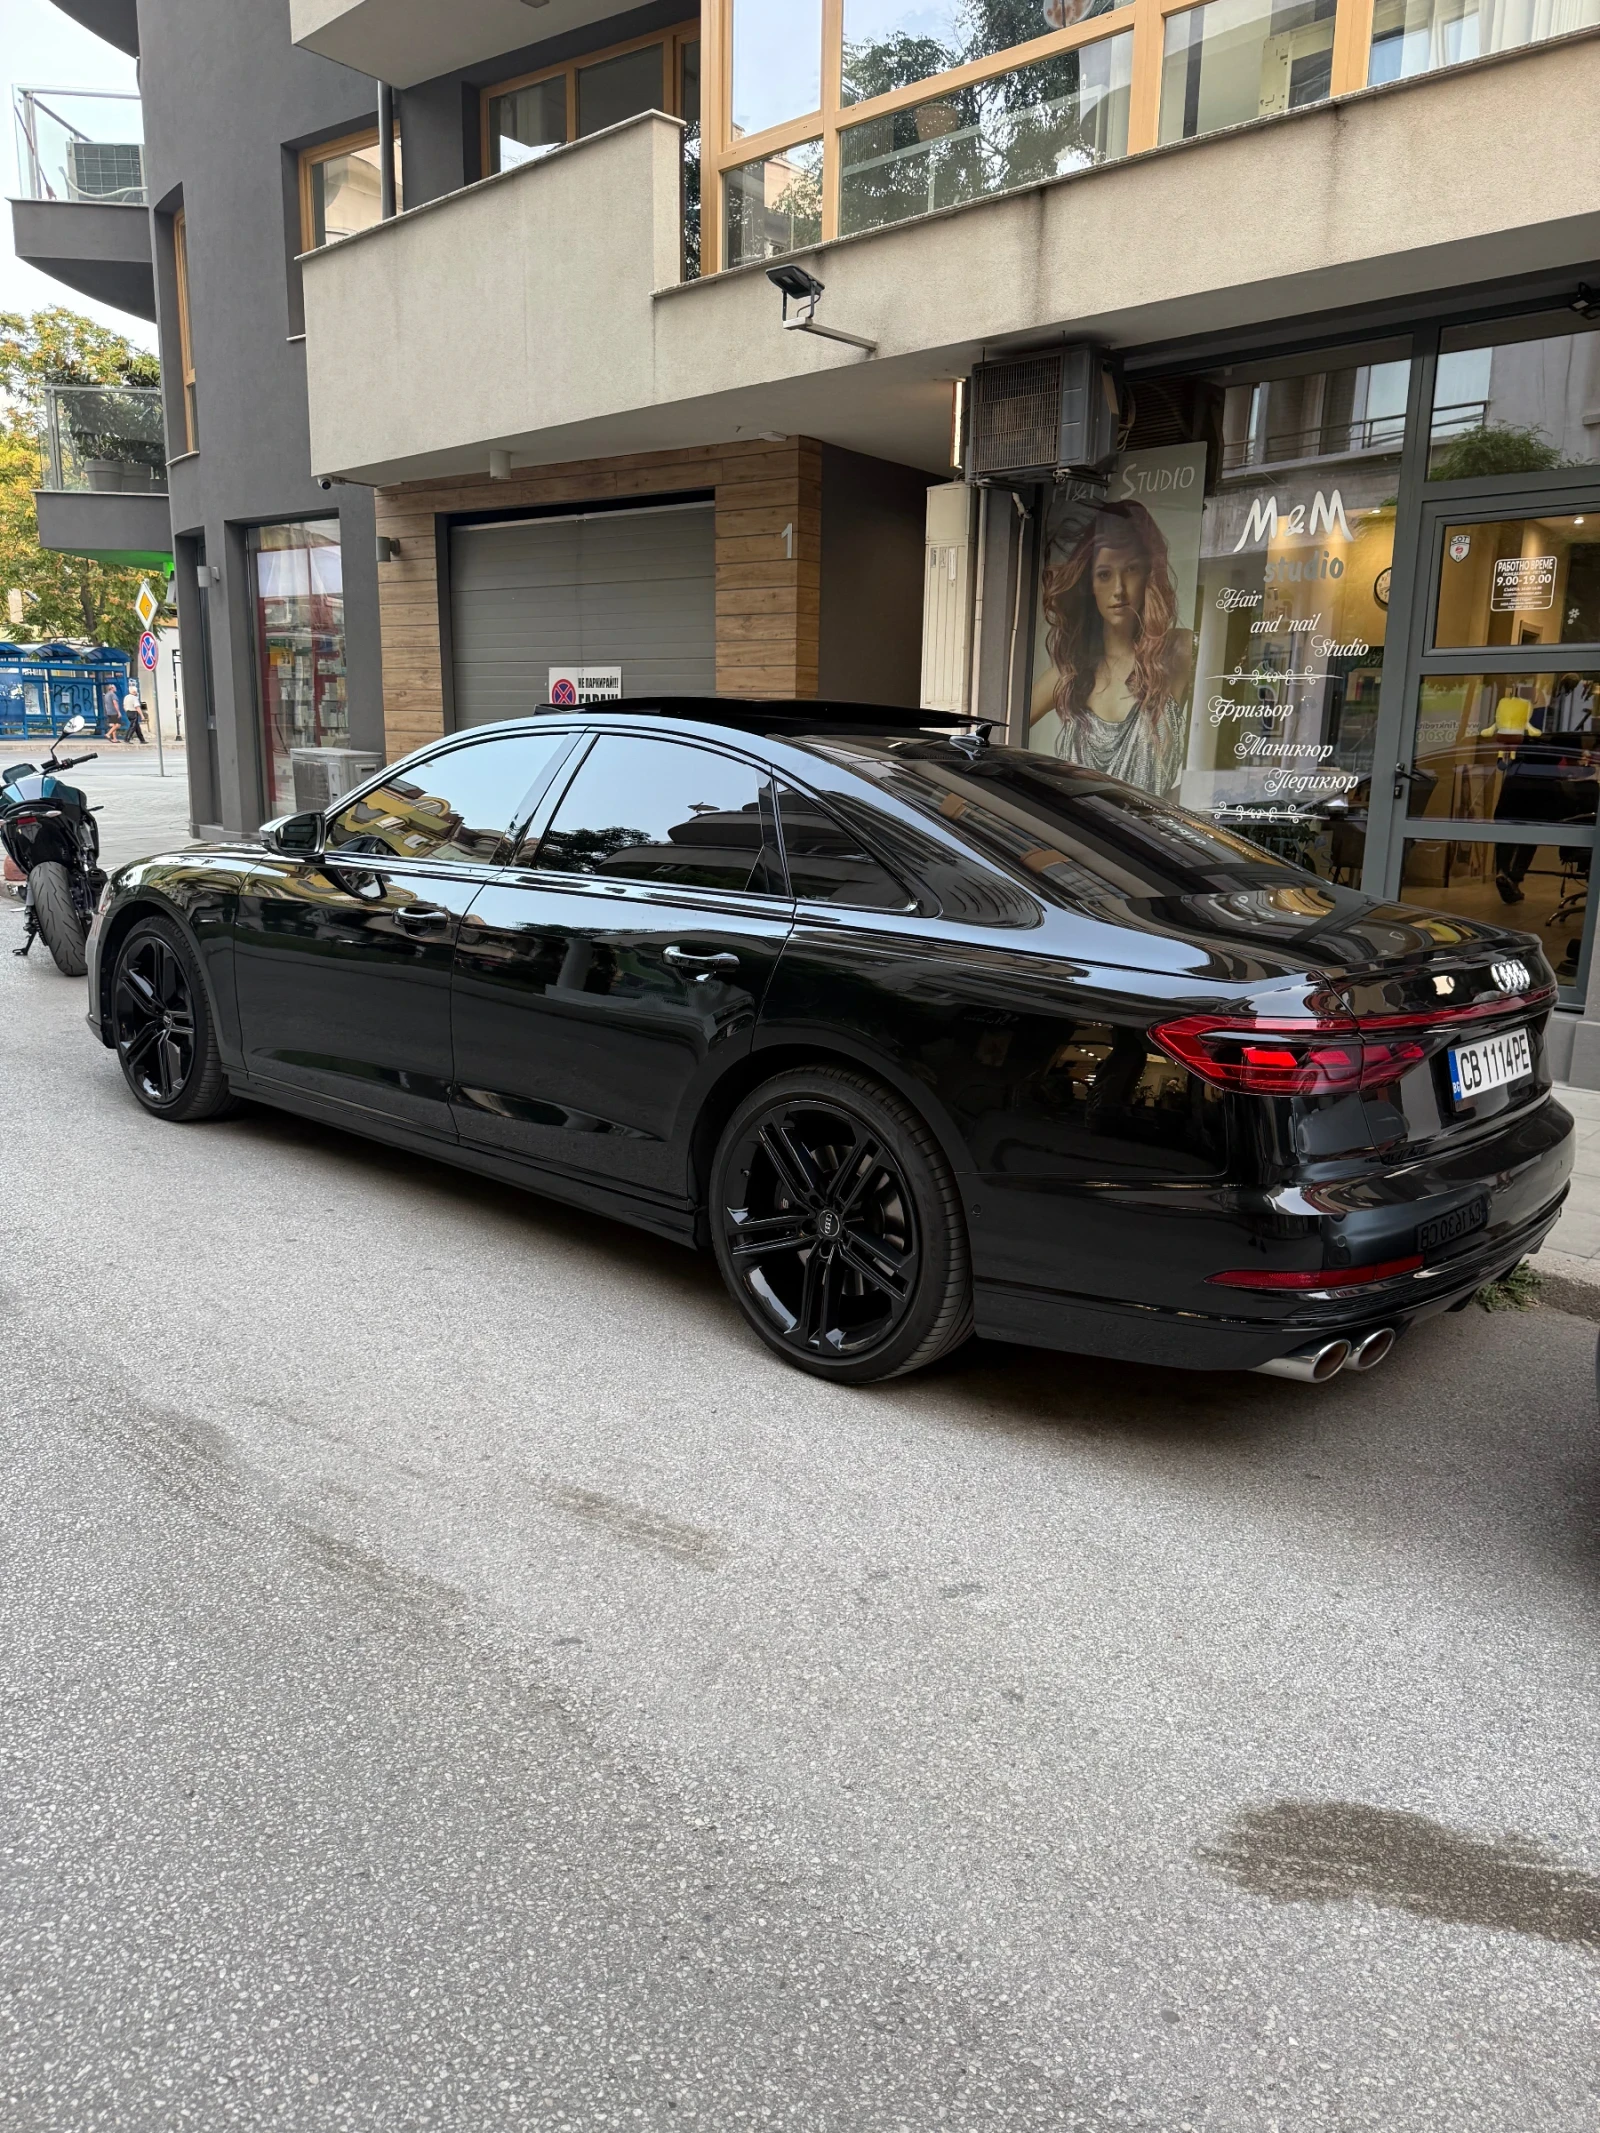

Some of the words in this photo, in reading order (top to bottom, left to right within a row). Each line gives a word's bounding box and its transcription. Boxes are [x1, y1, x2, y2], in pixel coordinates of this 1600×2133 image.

[1120, 463, 1195, 499] STUDIO
[1233, 489, 1354, 552] M&M
[781, 523, 793, 559] 1
[1263, 550, 1344, 582] studio
[1498, 561, 1529, 572] РАБОТНО
[1530, 559, 1553, 569] ВРЕМЕ
[1497, 574, 1552, 586] 9.00-19.00
[1216, 587, 1262, 612] Hair
[1250, 614, 1283, 633] and
[1288, 613, 1322, 631] nail
[1311, 635, 1369, 657] Studio
[578, 677, 584, 688] НЕ
[586, 675, 618, 688] ПАРКИРАЙ!!!
[1208, 695, 1294, 727] Фризьор
[1234, 732, 1333, 761] Маникюр
[1265, 768, 1359, 796] Педикюр
[1460, 1050, 1482, 1091] CB
